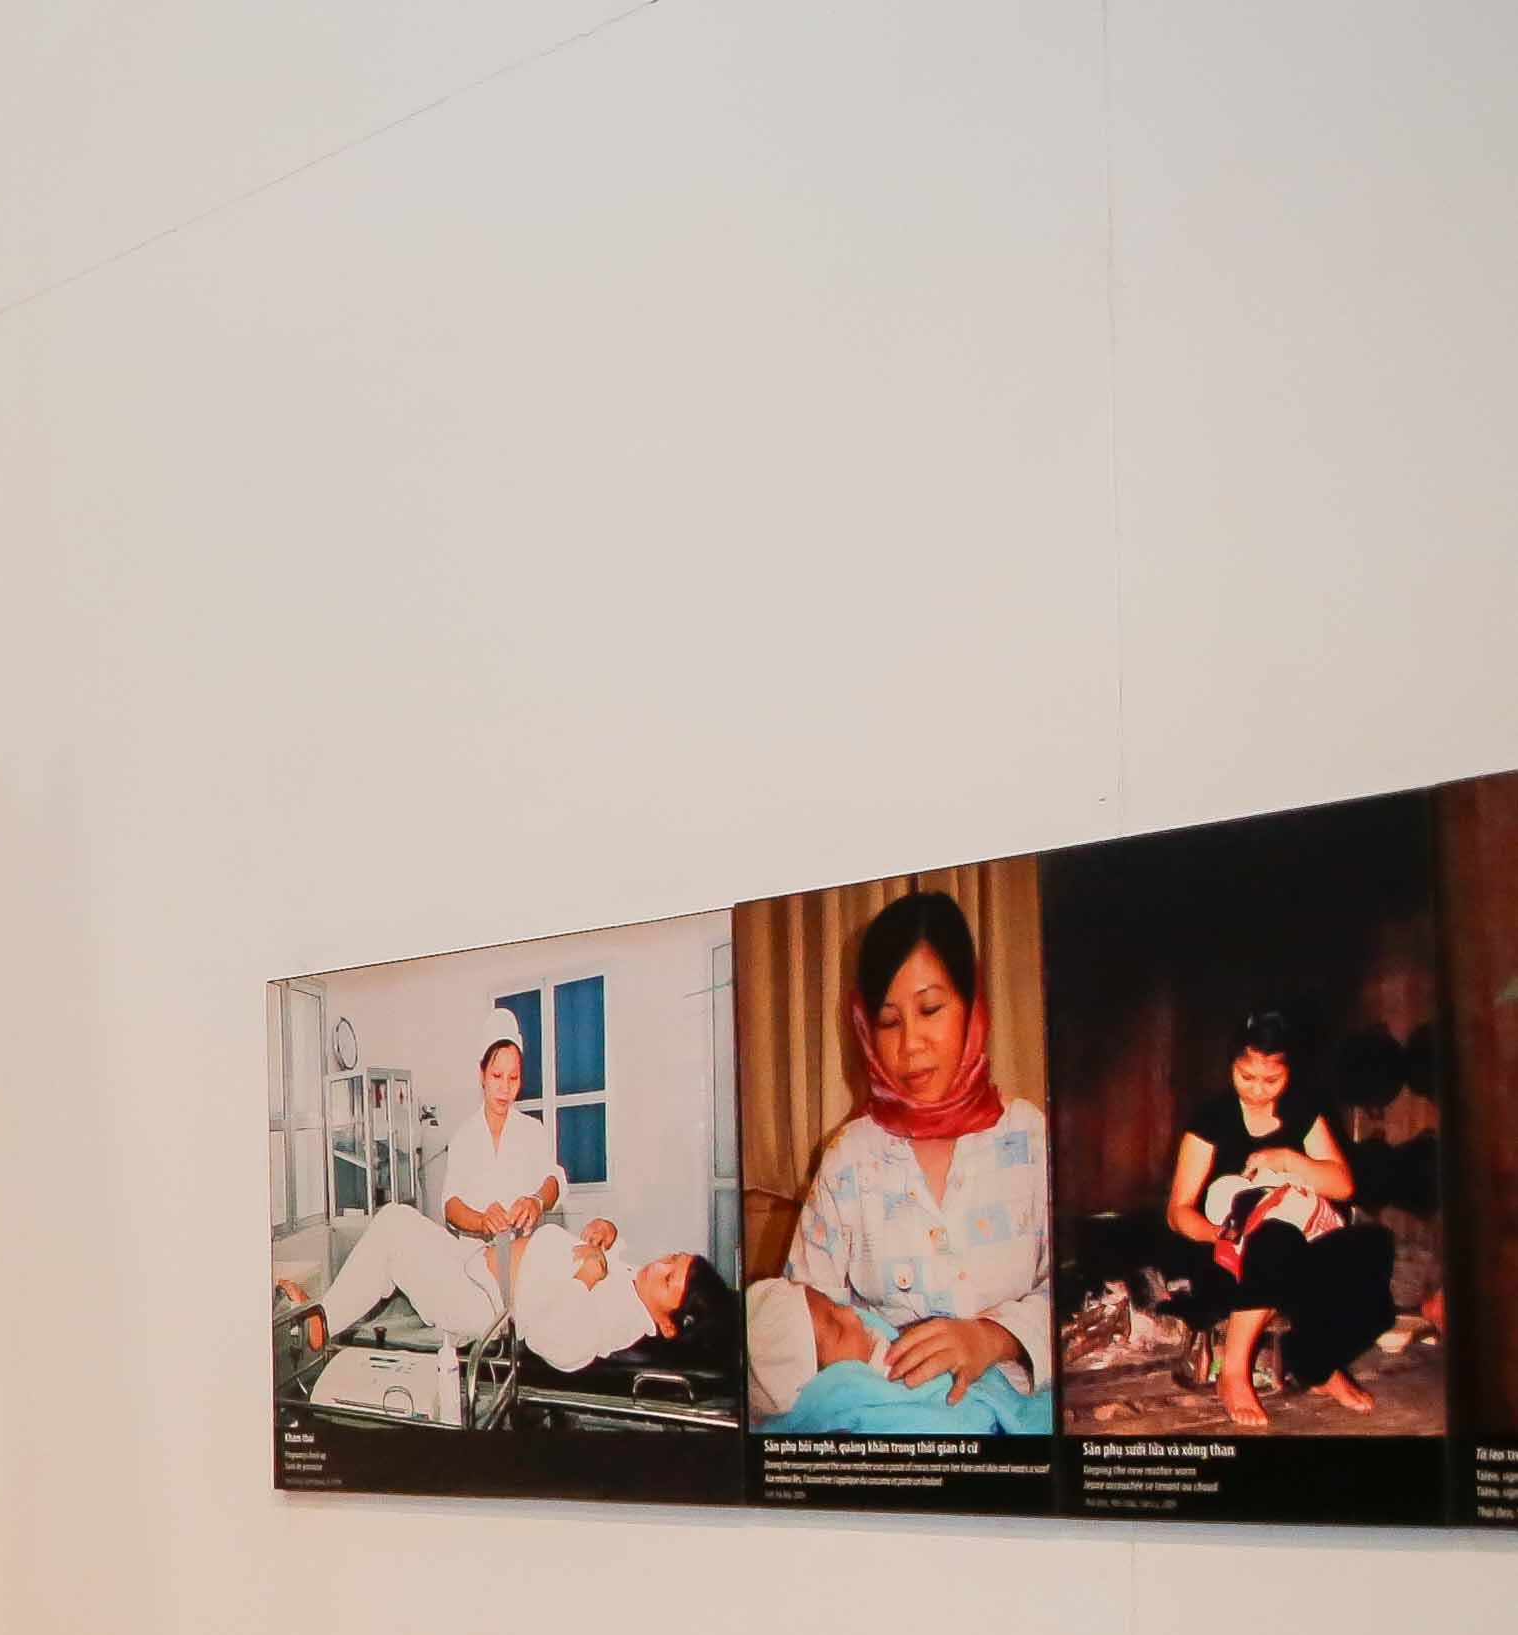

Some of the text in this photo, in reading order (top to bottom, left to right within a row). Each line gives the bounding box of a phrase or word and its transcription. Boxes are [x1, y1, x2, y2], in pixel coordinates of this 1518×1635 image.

[1083, 1442, 1101, 1456] Sản
[1103, 1442, 1122, 1458] phụ
[1167, 1443, 1180, 1456] và
[1210, 1443, 1235, 1456] than
